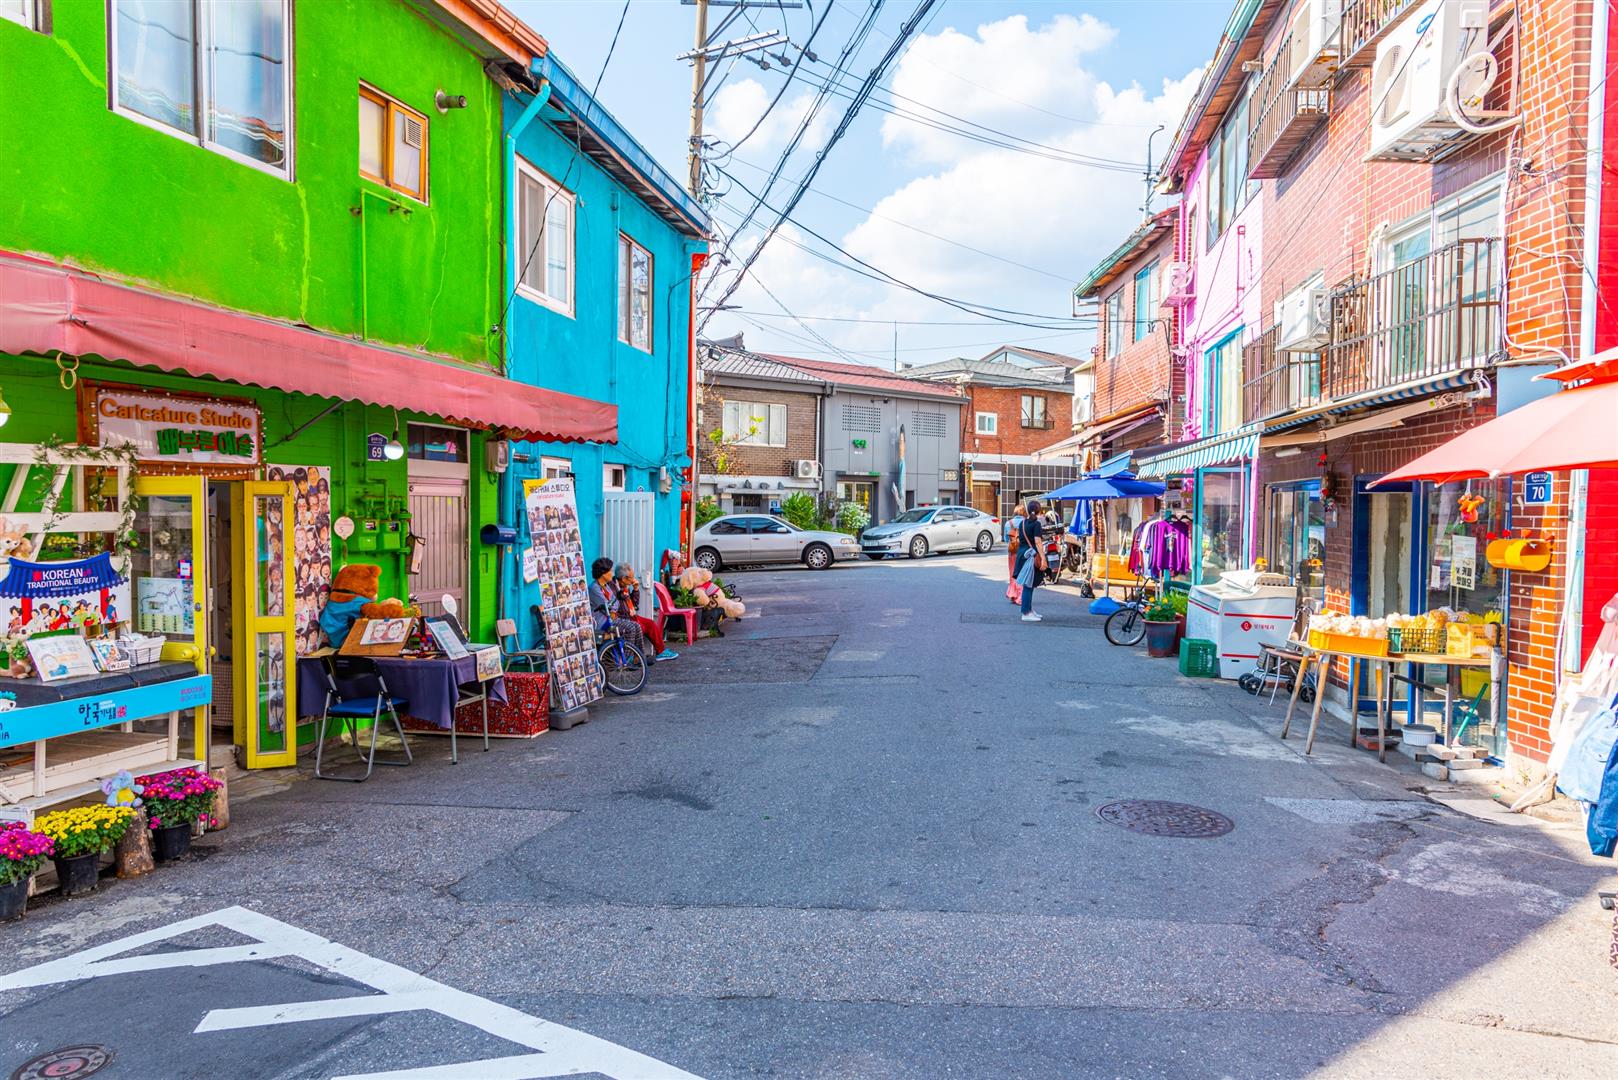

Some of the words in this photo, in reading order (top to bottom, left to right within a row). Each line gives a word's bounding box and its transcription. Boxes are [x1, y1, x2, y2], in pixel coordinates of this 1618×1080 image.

[99, 397, 198, 425] Caricature
[200, 408, 253, 429] Studio
[156, 428, 214, 456] 배부른
[217, 430, 255, 458] 예술
[371, 446, 382, 458] 69
[1531, 486, 1545, 500] 70
[42, 568, 84, 581] KOREAN
[26, 579, 73, 590] TRADITIONAL
[73, 575, 99, 586] BEAUTY
